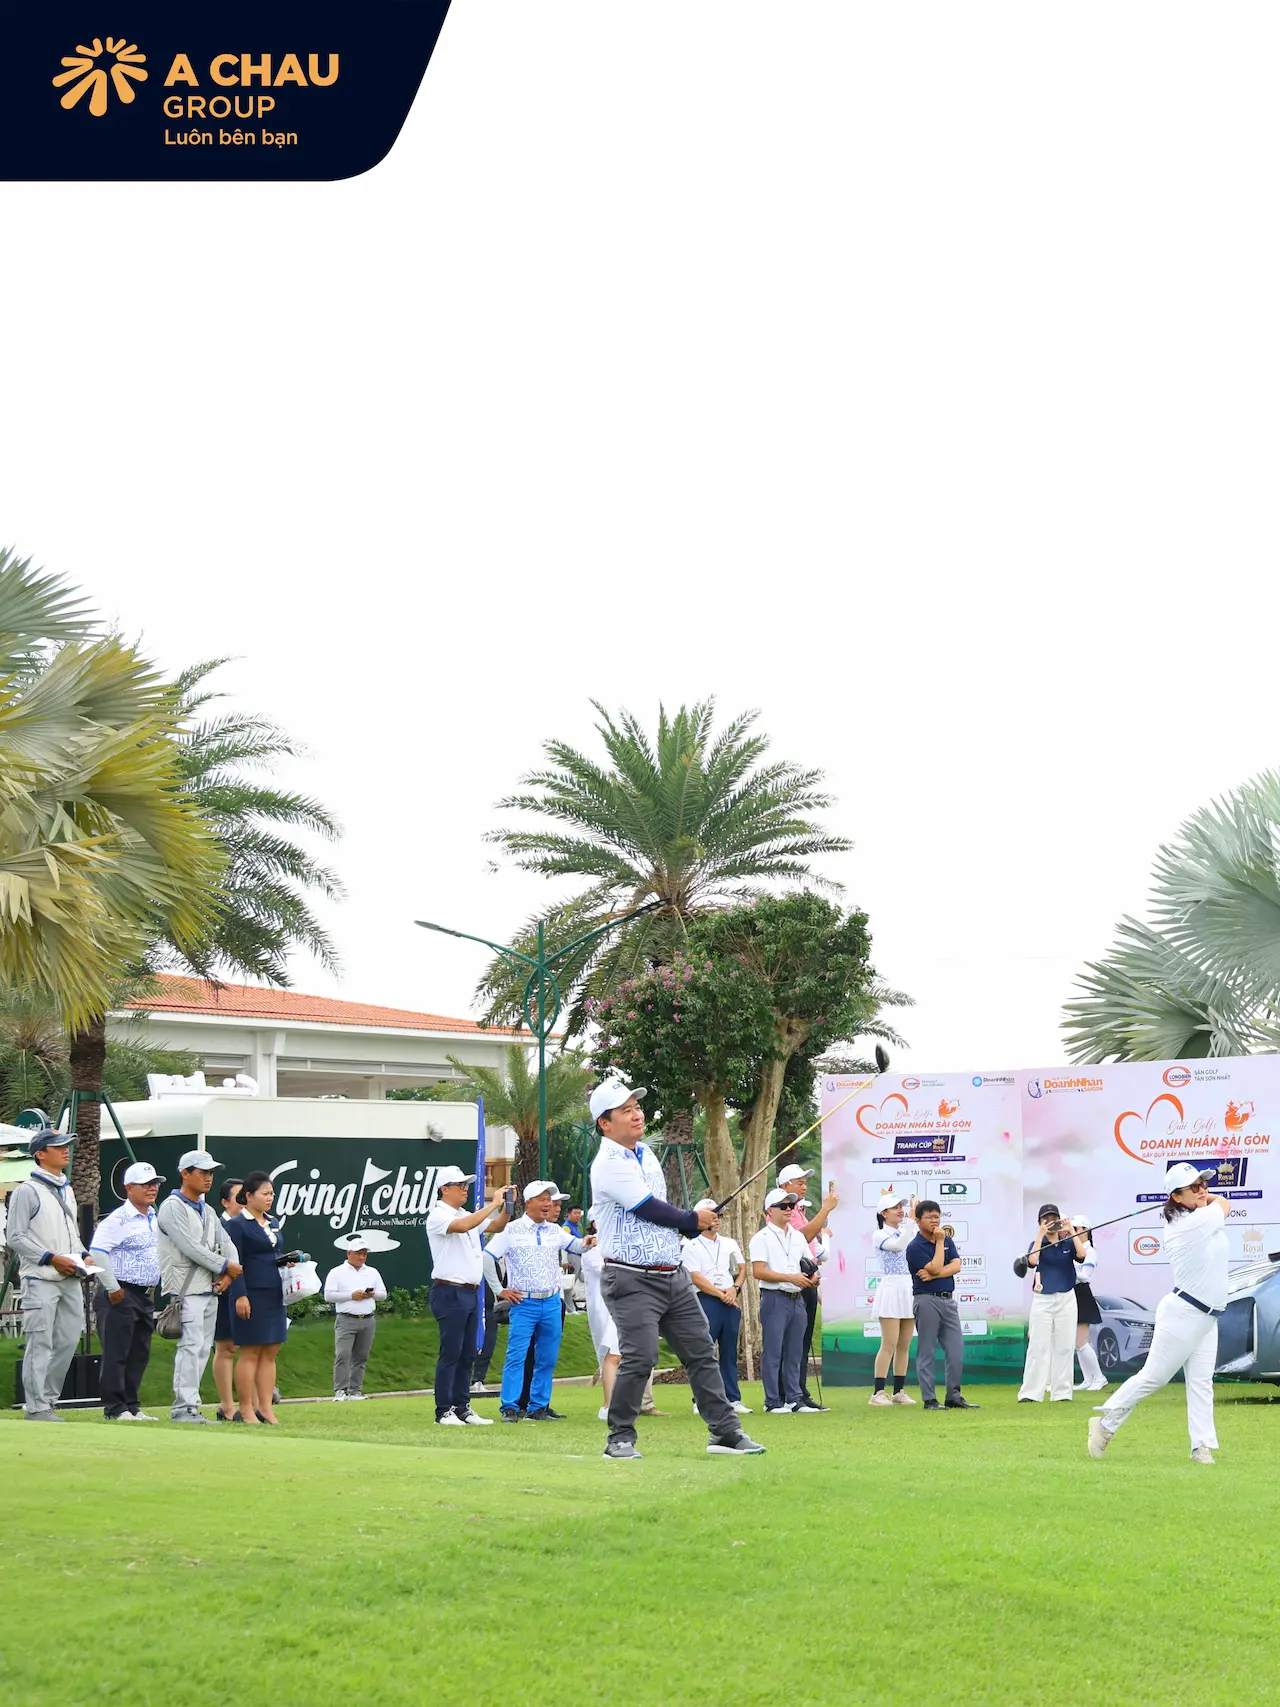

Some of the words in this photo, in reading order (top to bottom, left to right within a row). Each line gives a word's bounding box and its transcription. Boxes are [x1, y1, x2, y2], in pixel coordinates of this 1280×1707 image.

[875, 1122, 907, 1130] DOANH
[918, 1140, 932, 1149] CÚP
[1140, 1138, 1182, 1150] DOANH
[1184, 1135, 1219, 1148] NHÂN
[1221, 1133, 1241, 1146] SÀI
[1243, 1133, 1270, 1146] GÒN
[362, 1204, 370, 1216] &
[360, 1218, 368, 1227] by
[405, 1217, 418, 1227] Golf
